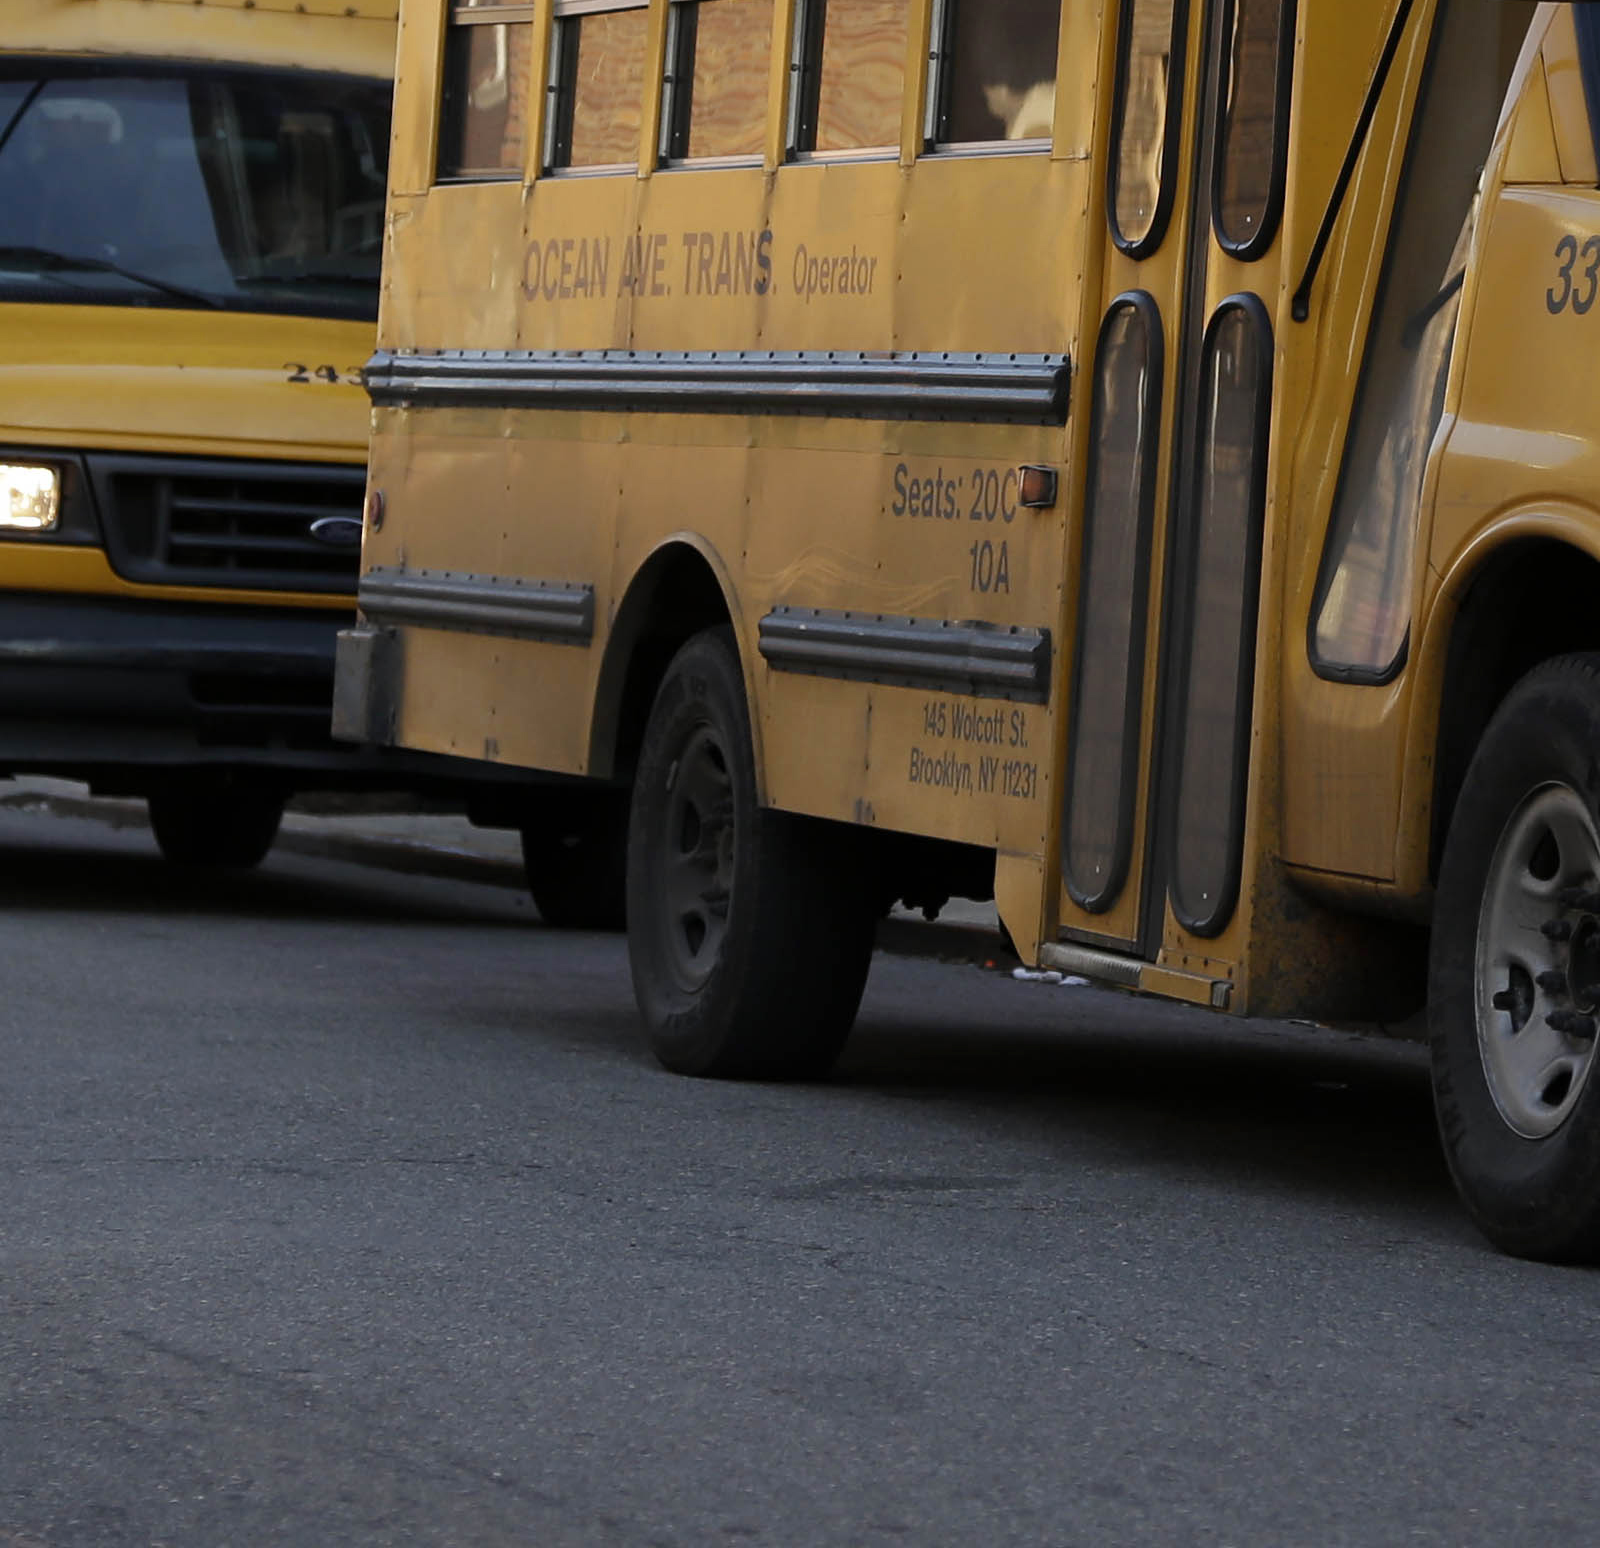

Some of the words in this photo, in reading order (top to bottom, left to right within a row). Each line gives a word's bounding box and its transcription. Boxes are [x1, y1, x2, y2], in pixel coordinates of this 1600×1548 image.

[522, 237, 610, 302] OCEAN
[617, 233, 671, 299] AVE.
[682, 229, 777, 297] TRANS.
[792, 243, 878, 305] Operator
[891, 462, 963, 520] Seats:
[968, 467, 1018, 524] 20C
[969, 539, 1010, 594] 10A
[923, 702, 946, 738] 145
[952, 703, 1005, 745] Wolcott
[1009, 709, 1028, 749] St.
[908, 747, 974, 797] Brooklyn,
[978, 755, 1000, 793] NY
[1002, 759, 1038, 799] 11231
